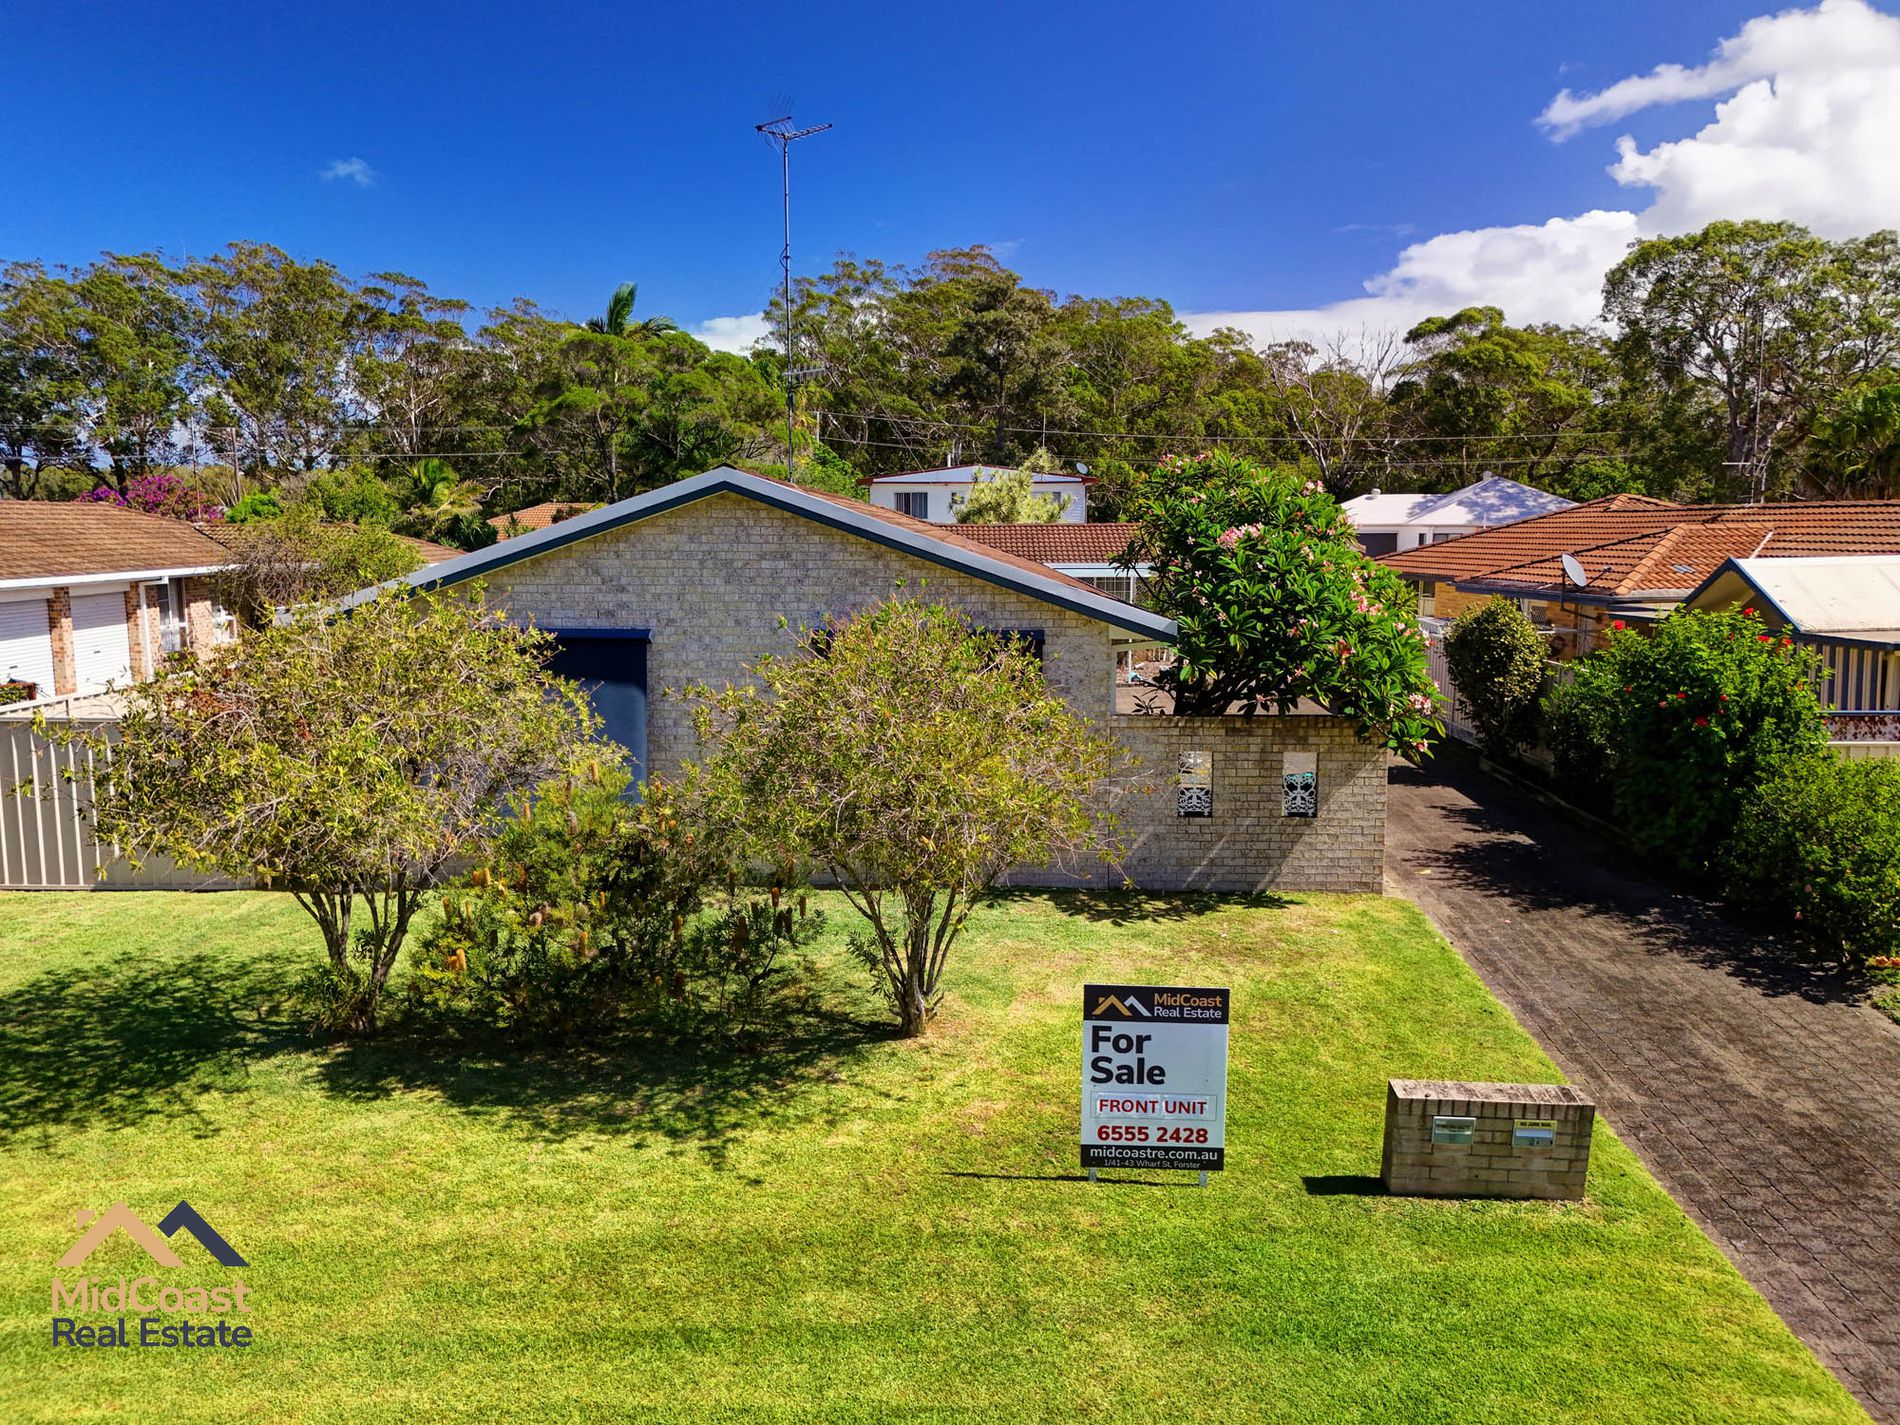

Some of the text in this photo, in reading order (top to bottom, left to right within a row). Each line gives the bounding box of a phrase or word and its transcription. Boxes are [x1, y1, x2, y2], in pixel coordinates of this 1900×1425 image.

[1154, 993, 1222, 1008] MidCoast
[1154, 1007, 1222, 1019] Real Estate
[1091, 1025, 1152, 1054] For
[1090, 1056, 1166, 1085] Sale
[1098, 1099, 1208, 1115] FRONT UNIT
[1097, 1125, 1208, 1144] 6555 2428
[1090, 1147, 1218, 1160] midcoastre.com.au
[1136, 1160, 1161, 1168] Wharf
[1174, 1161, 1200, 1169] Forster
